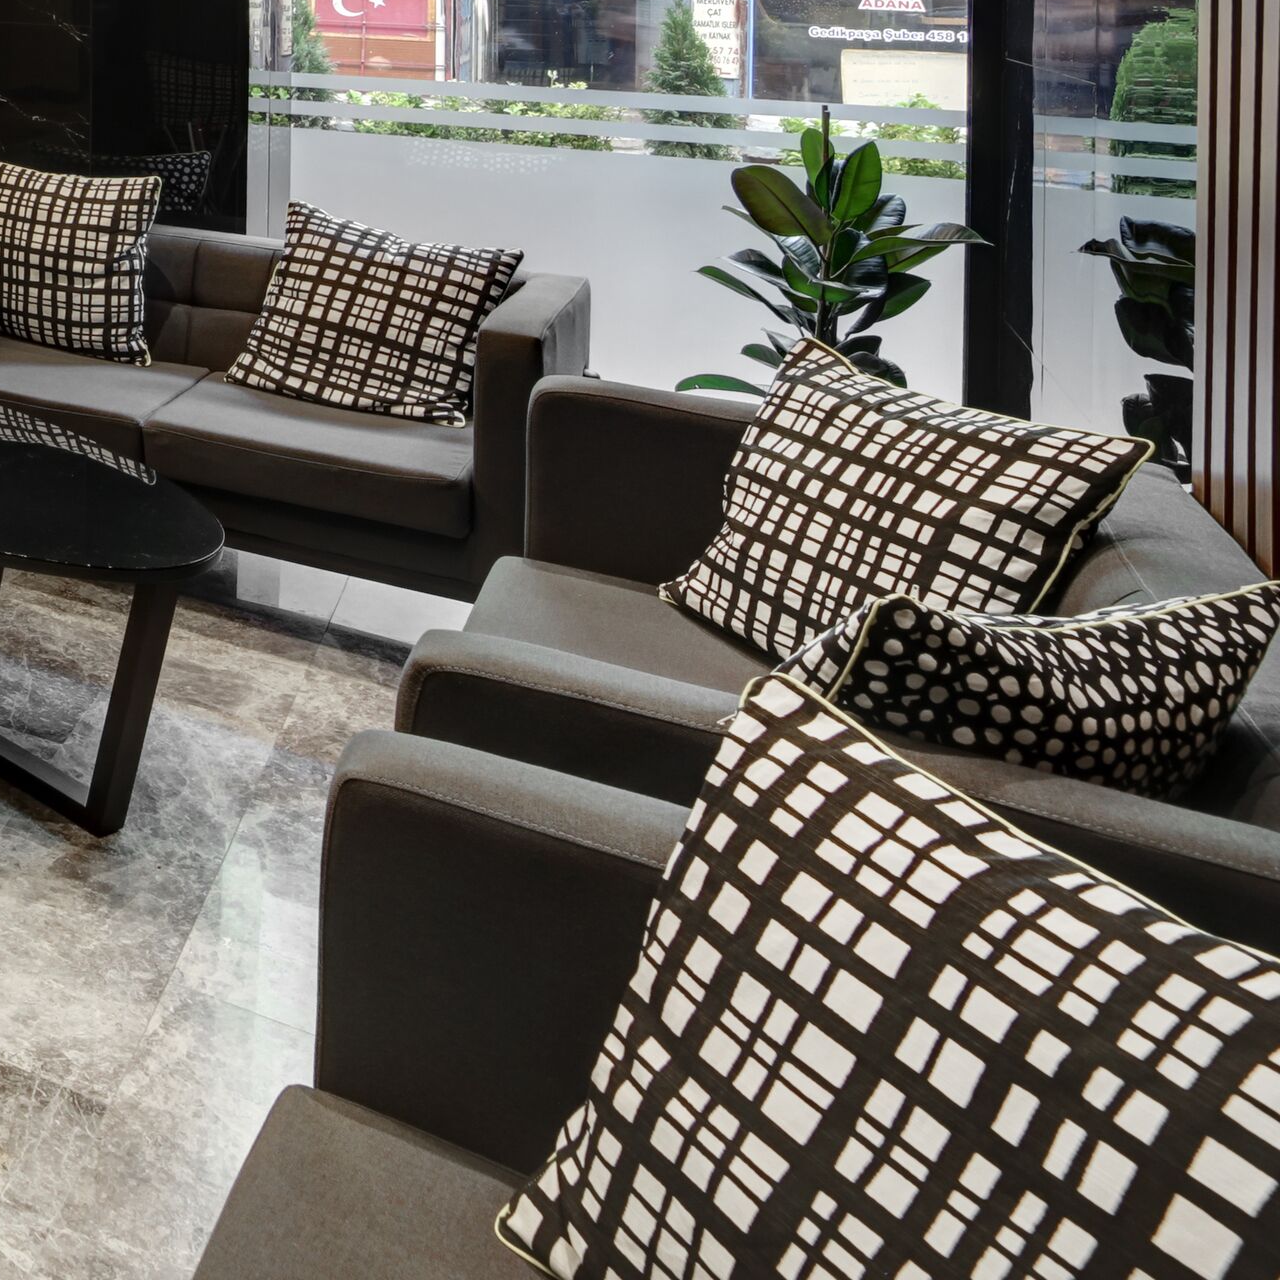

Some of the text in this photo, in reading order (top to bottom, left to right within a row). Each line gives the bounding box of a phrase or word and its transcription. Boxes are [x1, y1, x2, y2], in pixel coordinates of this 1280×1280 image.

[808, 26, 881, 42] Gedikpaşa
[883, 29, 924, 43] Şube:
[926, 31, 954, 42] 458
